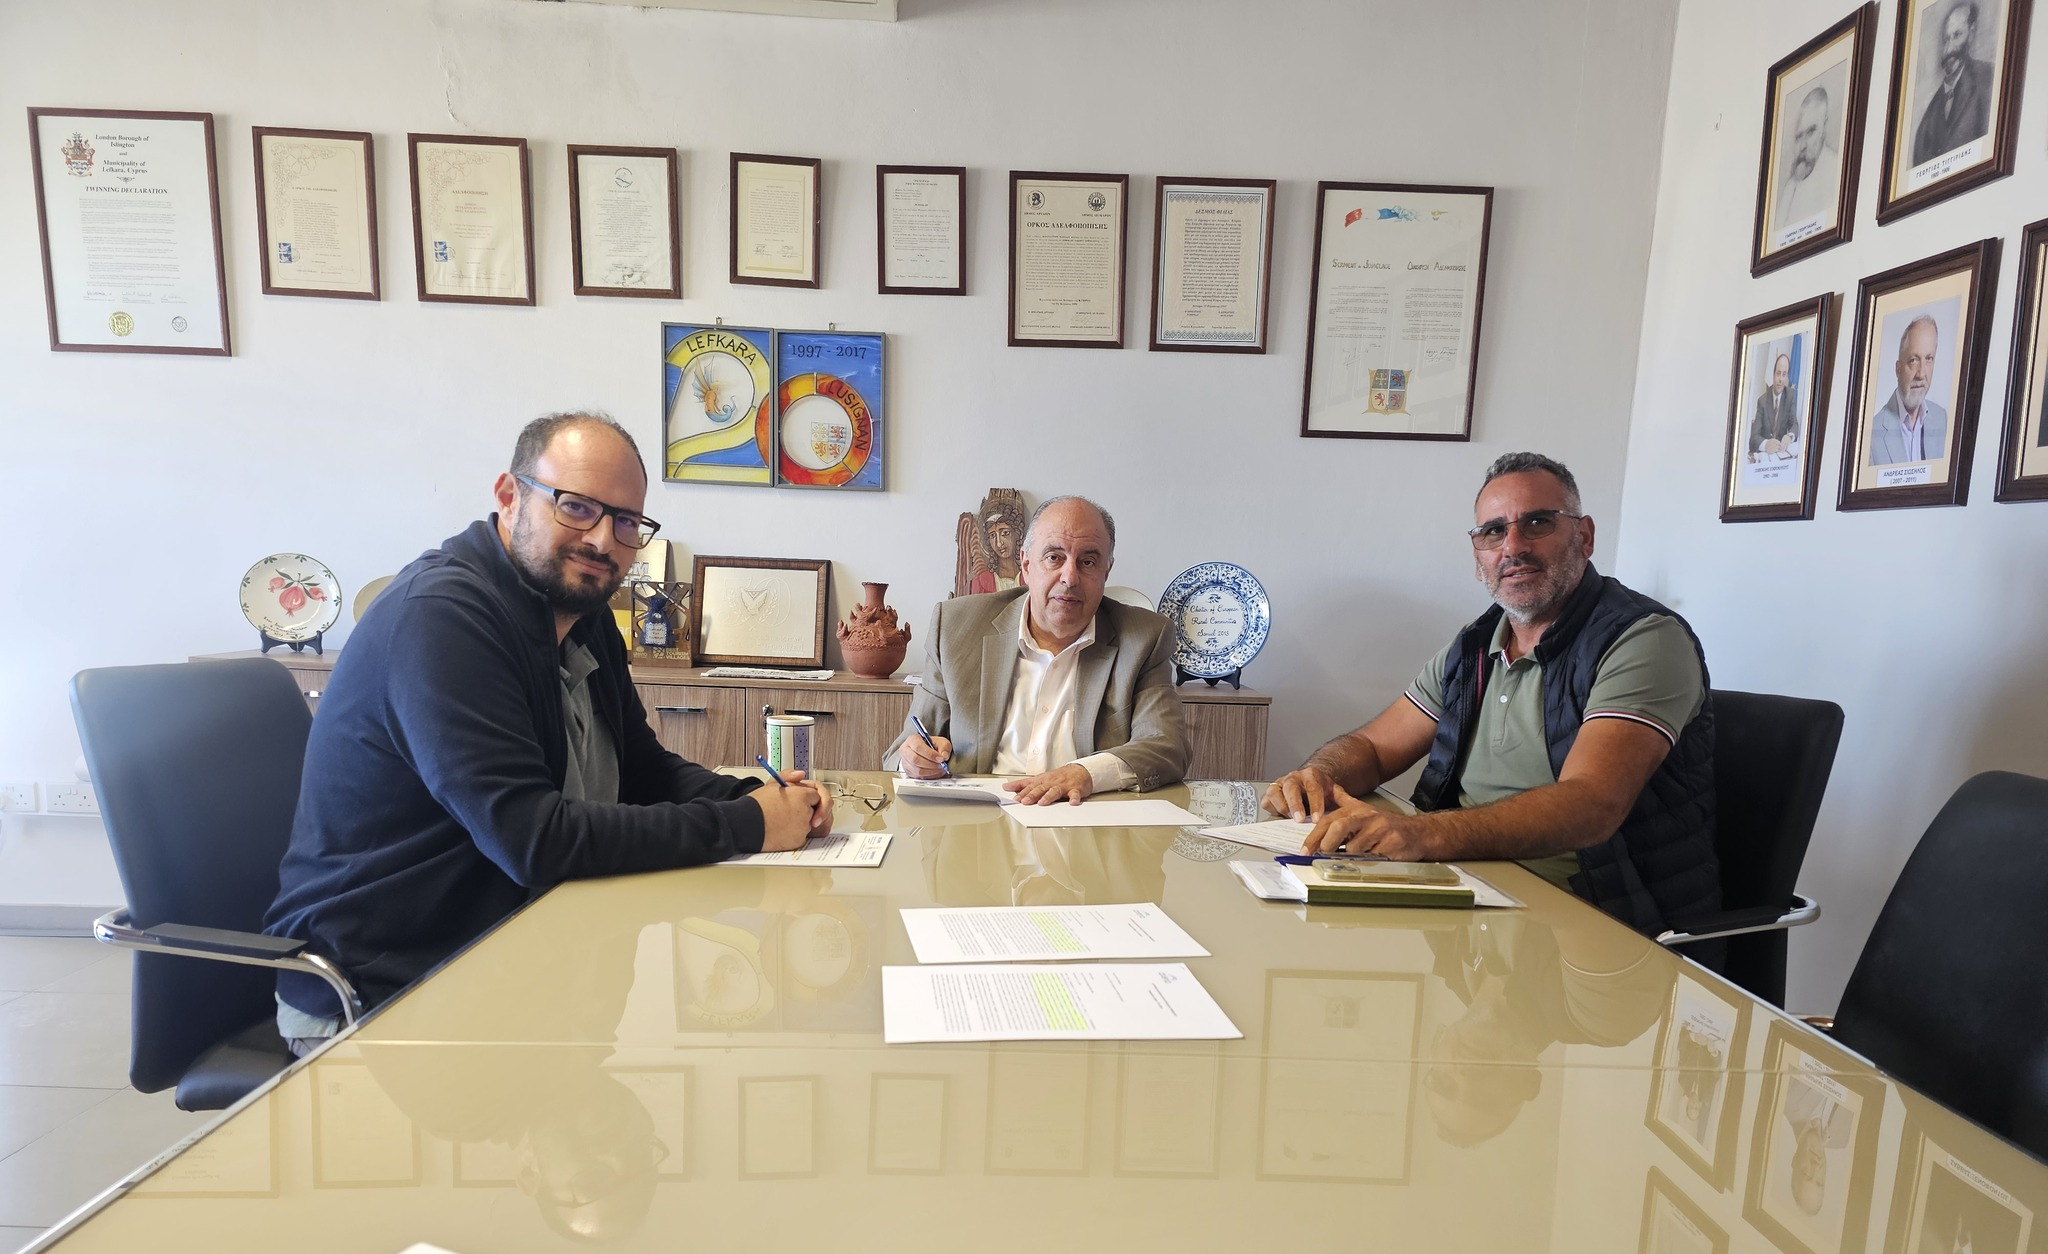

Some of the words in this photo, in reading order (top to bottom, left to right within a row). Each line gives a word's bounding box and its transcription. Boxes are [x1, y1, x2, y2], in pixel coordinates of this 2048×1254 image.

[686, 334, 757, 365] LEFKARA
[792, 344, 822, 358] 1997
[836, 346, 867, 359] 2017
[827, 381, 867, 451] LUSIGNAN
